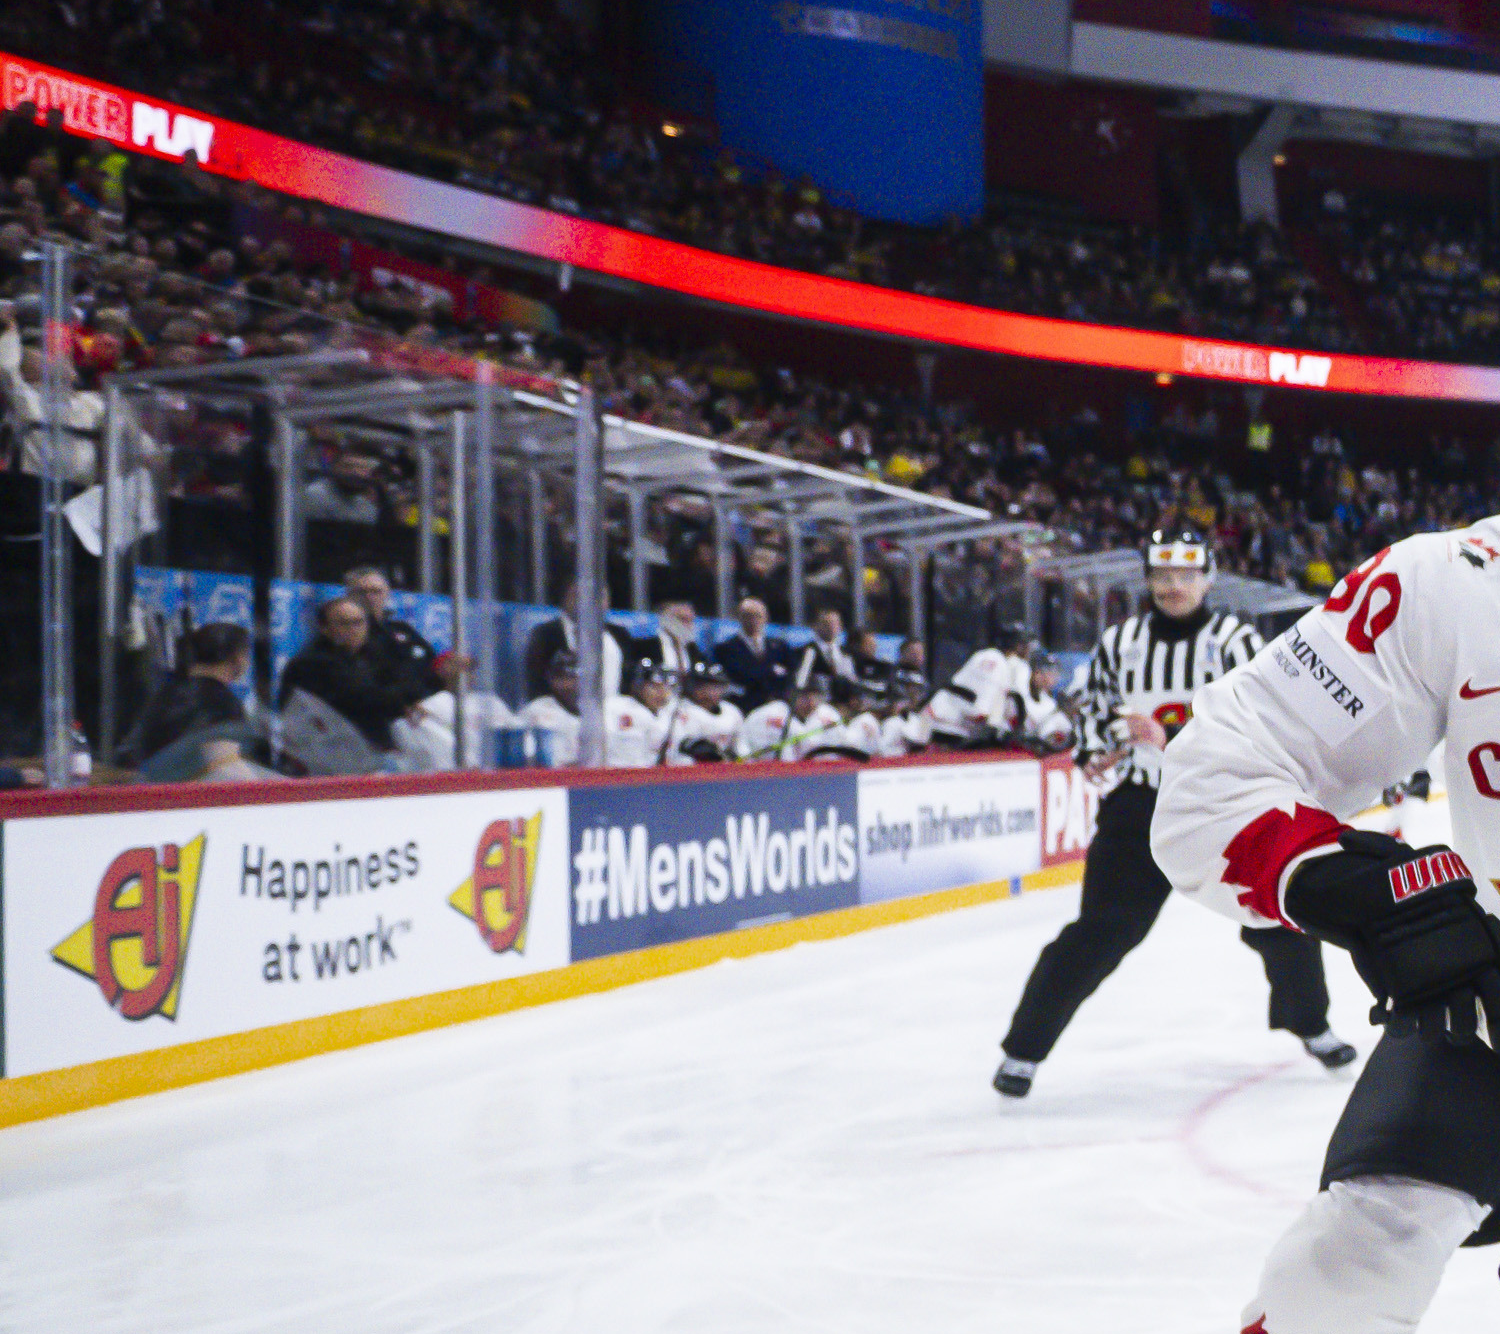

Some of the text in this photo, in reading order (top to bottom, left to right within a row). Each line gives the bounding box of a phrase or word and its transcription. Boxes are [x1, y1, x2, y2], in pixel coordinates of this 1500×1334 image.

[132, 100, 216, 165] PLAY
[1268, 351, 1333, 388] PLAY
[239, 839, 421, 912] Happiness
[573, 805, 858, 927] #MensWorlds
[261, 934, 302, 984] at
